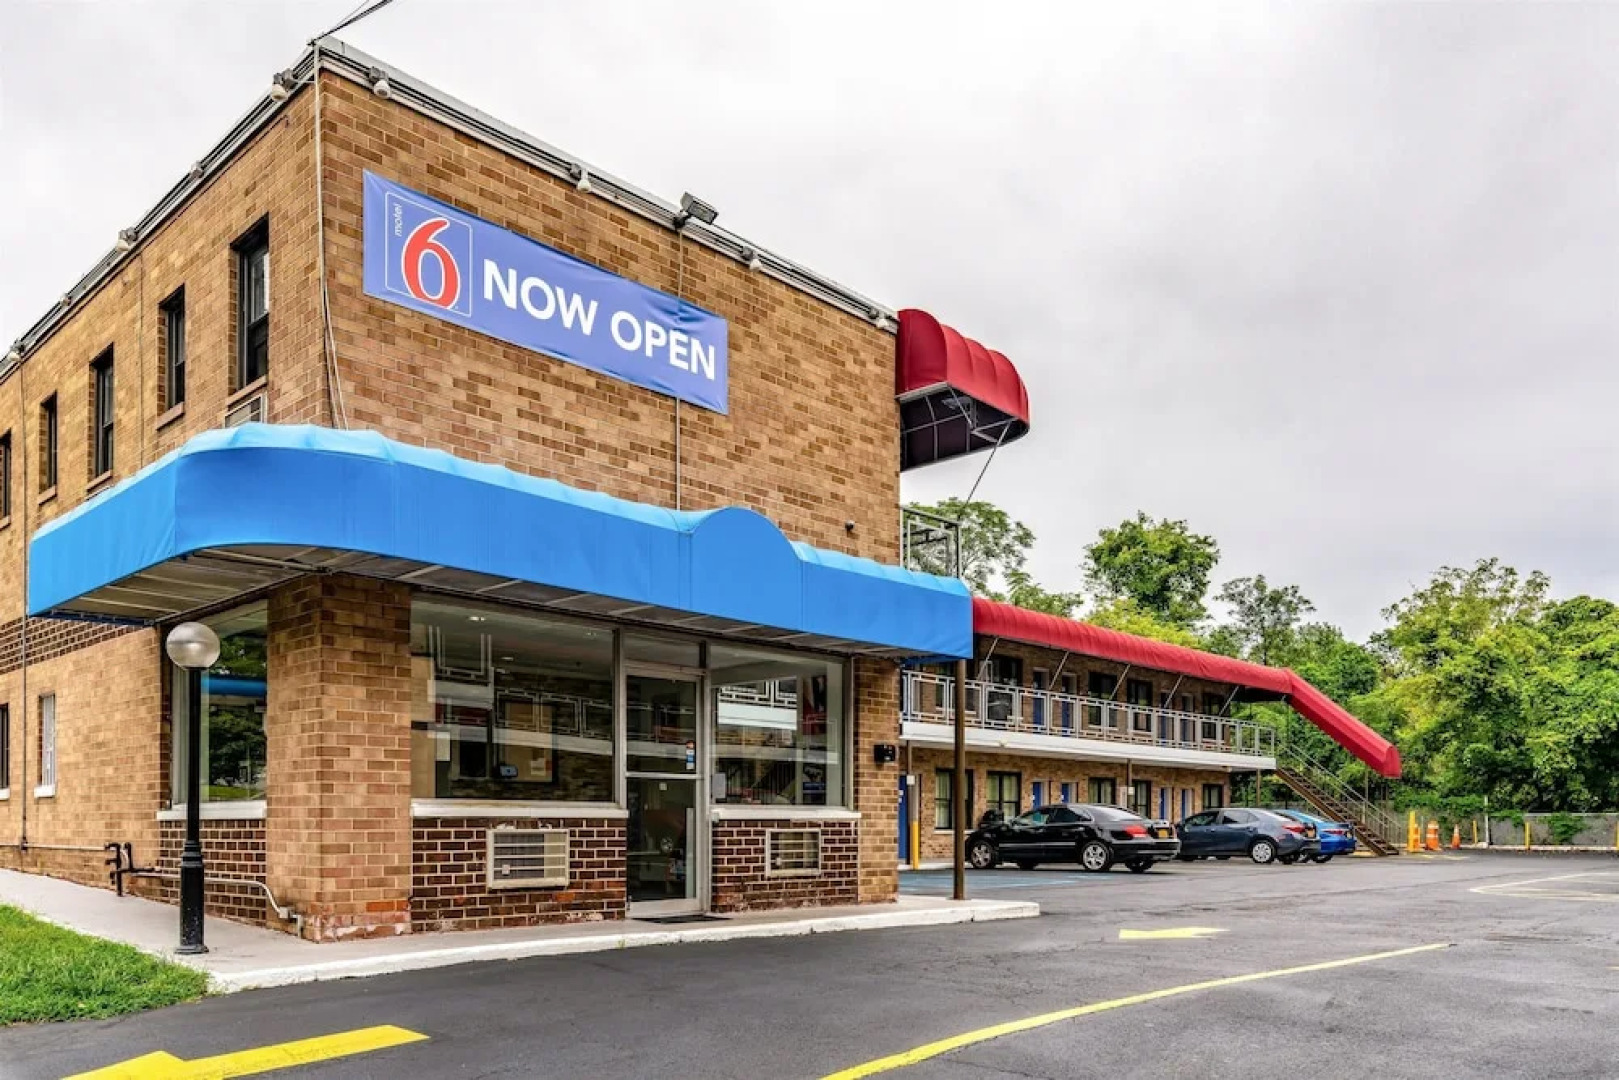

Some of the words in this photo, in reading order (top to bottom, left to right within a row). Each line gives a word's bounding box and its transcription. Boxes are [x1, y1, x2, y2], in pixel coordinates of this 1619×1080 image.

[393, 203, 402, 237] motel
[402, 217, 460, 309] 6
[483, 259, 598, 336] NOW
[611, 310, 715, 380] OPEN
